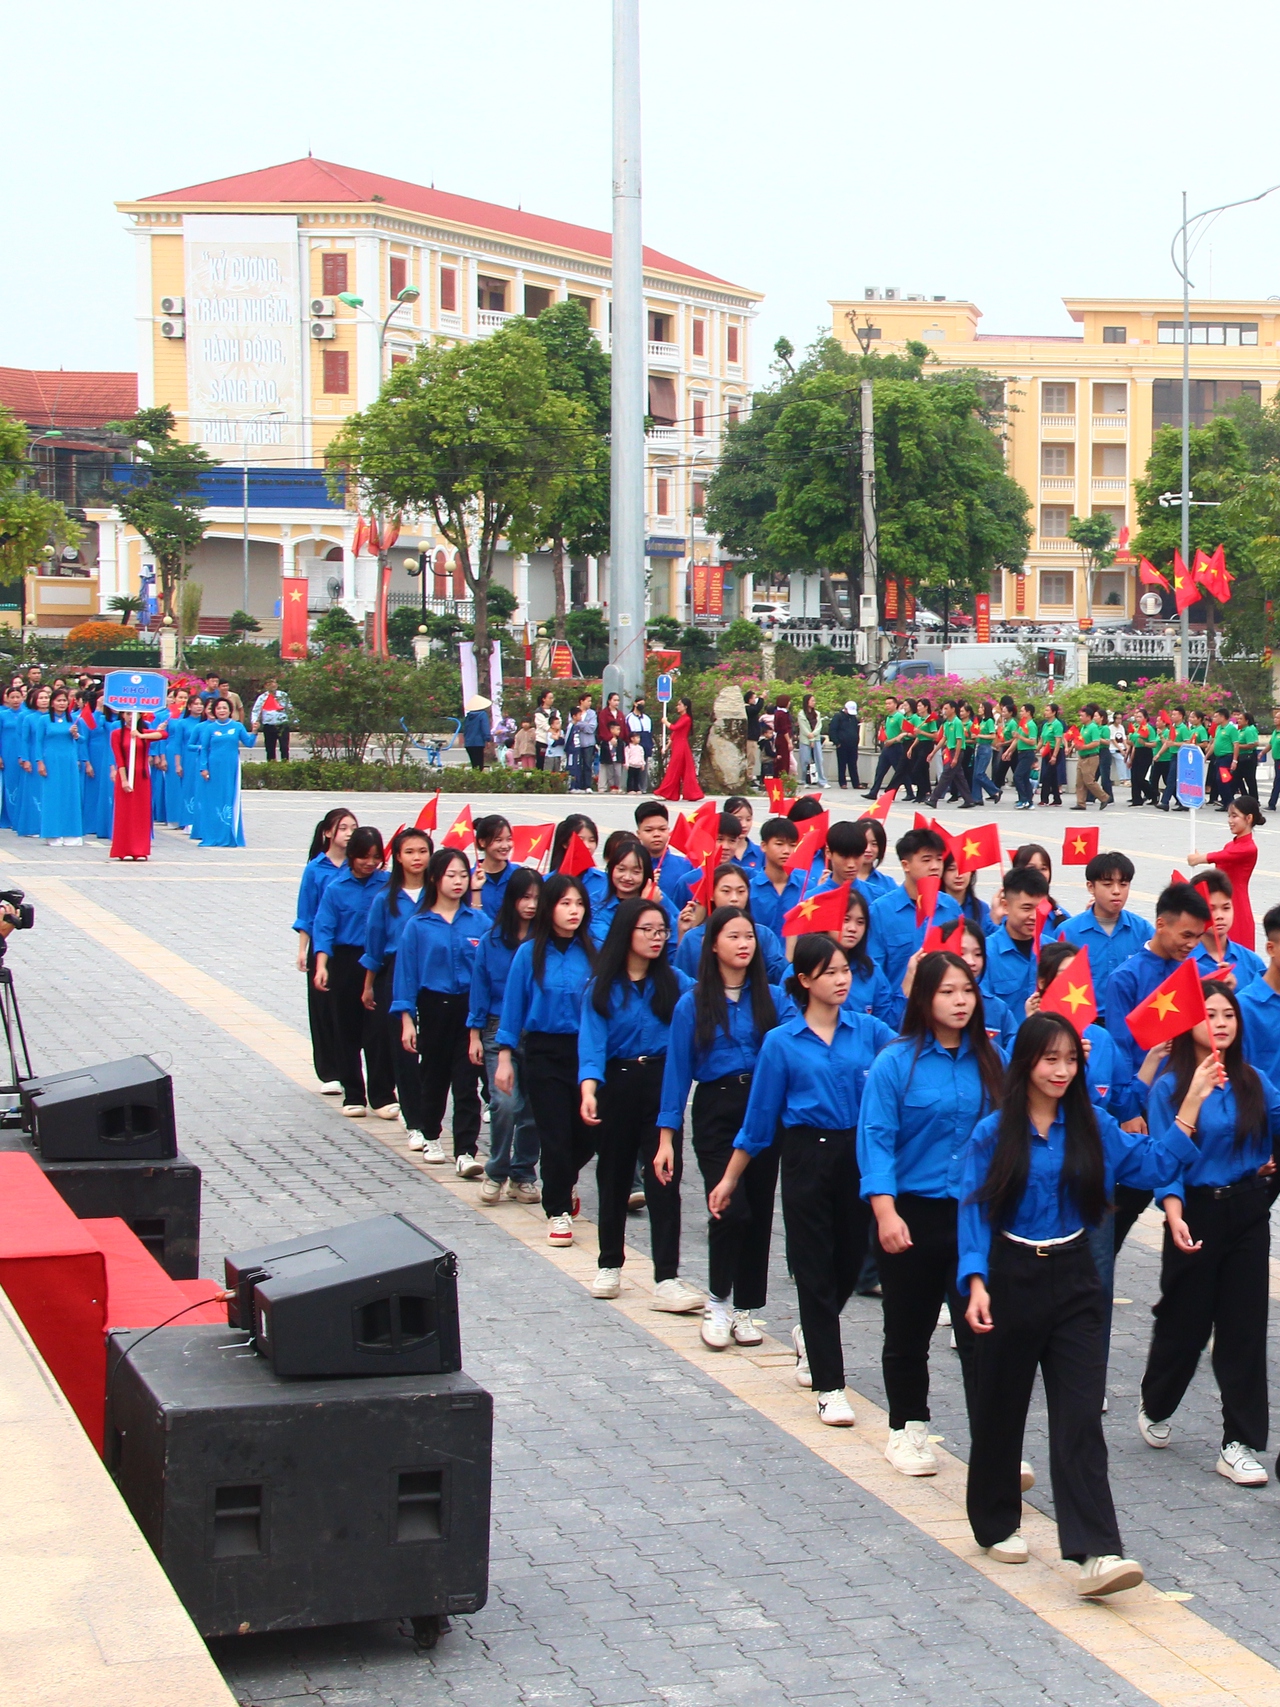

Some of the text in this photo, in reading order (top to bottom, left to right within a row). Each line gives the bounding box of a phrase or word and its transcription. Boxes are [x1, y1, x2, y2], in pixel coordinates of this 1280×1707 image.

[196, 294, 292, 327] TRÁCH NHIỆM,
[204, 333, 286, 367] HÀNH ĐỘNG,
[211, 375, 247, 402] SÁNG
[204, 416, 237, 443] PHÁT
[109, 695, 137, 705] PHỤ
